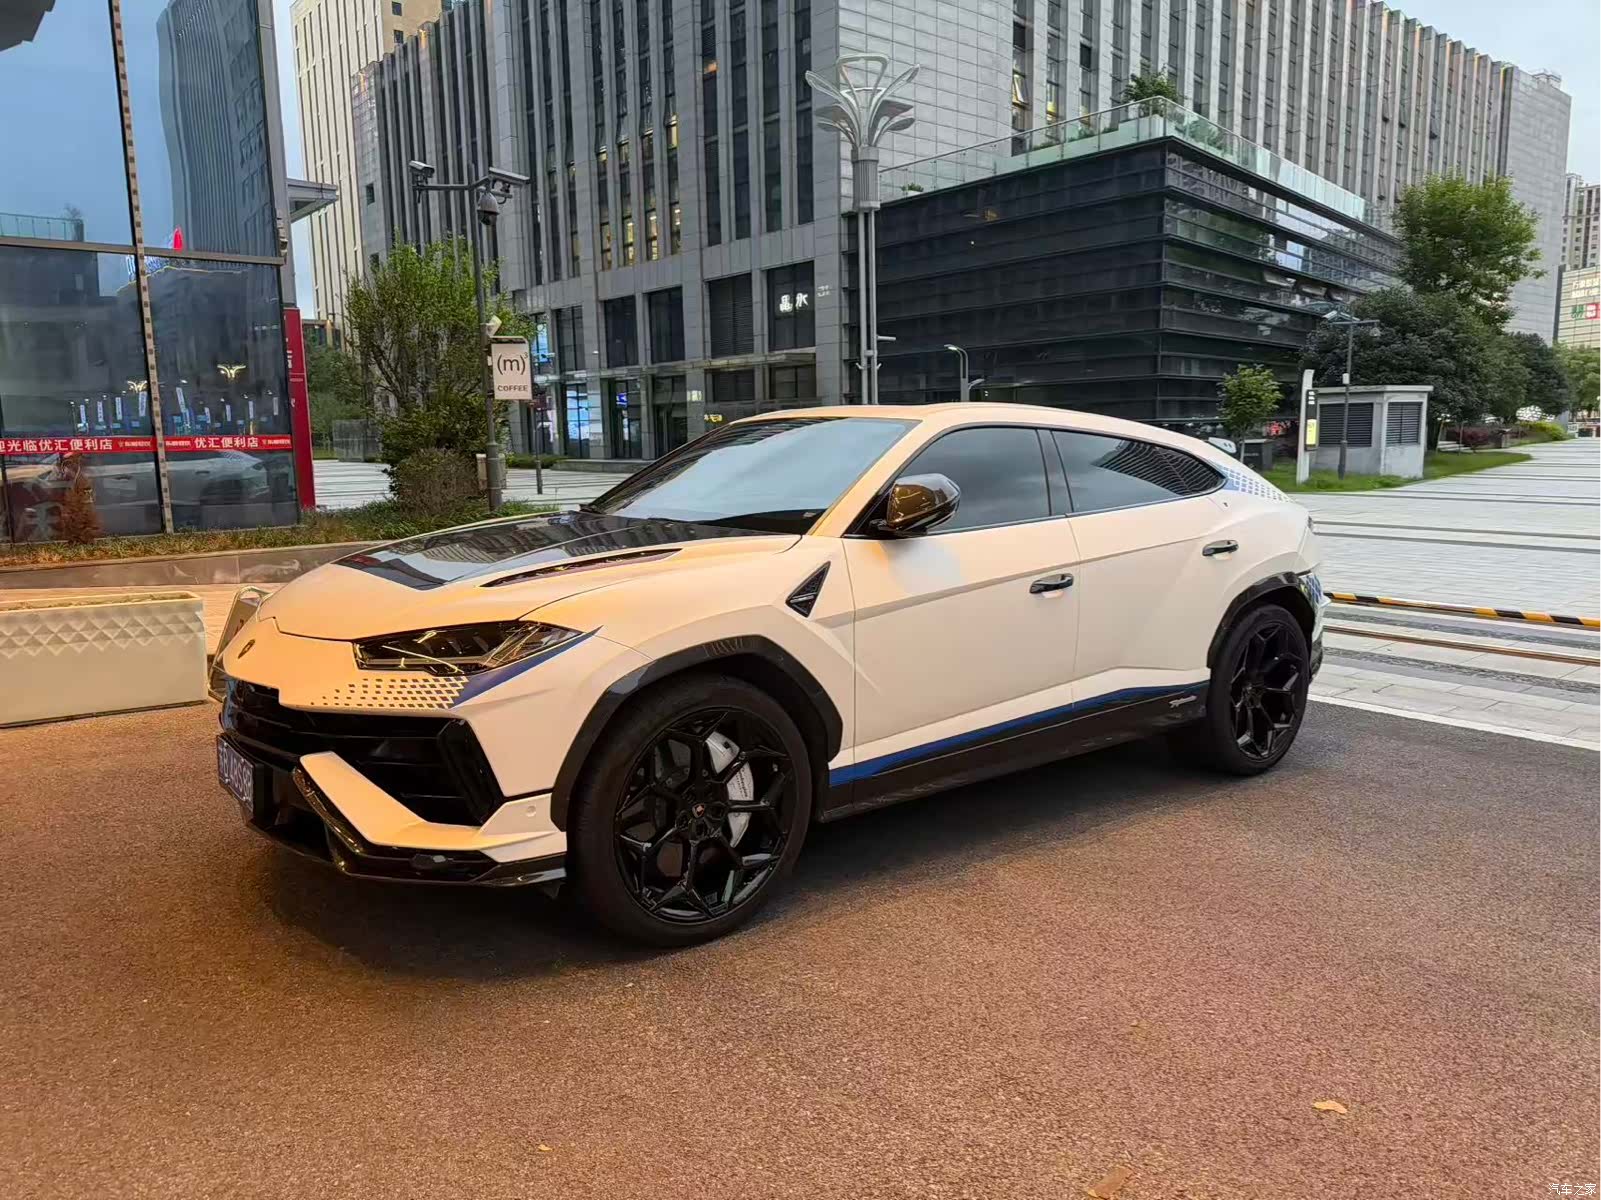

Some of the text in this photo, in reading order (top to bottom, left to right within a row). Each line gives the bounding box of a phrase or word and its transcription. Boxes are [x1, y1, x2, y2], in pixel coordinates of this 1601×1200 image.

[497, 384, 529, 392] COFFEE
[194, 436, 259, 449] 优汇便利店
